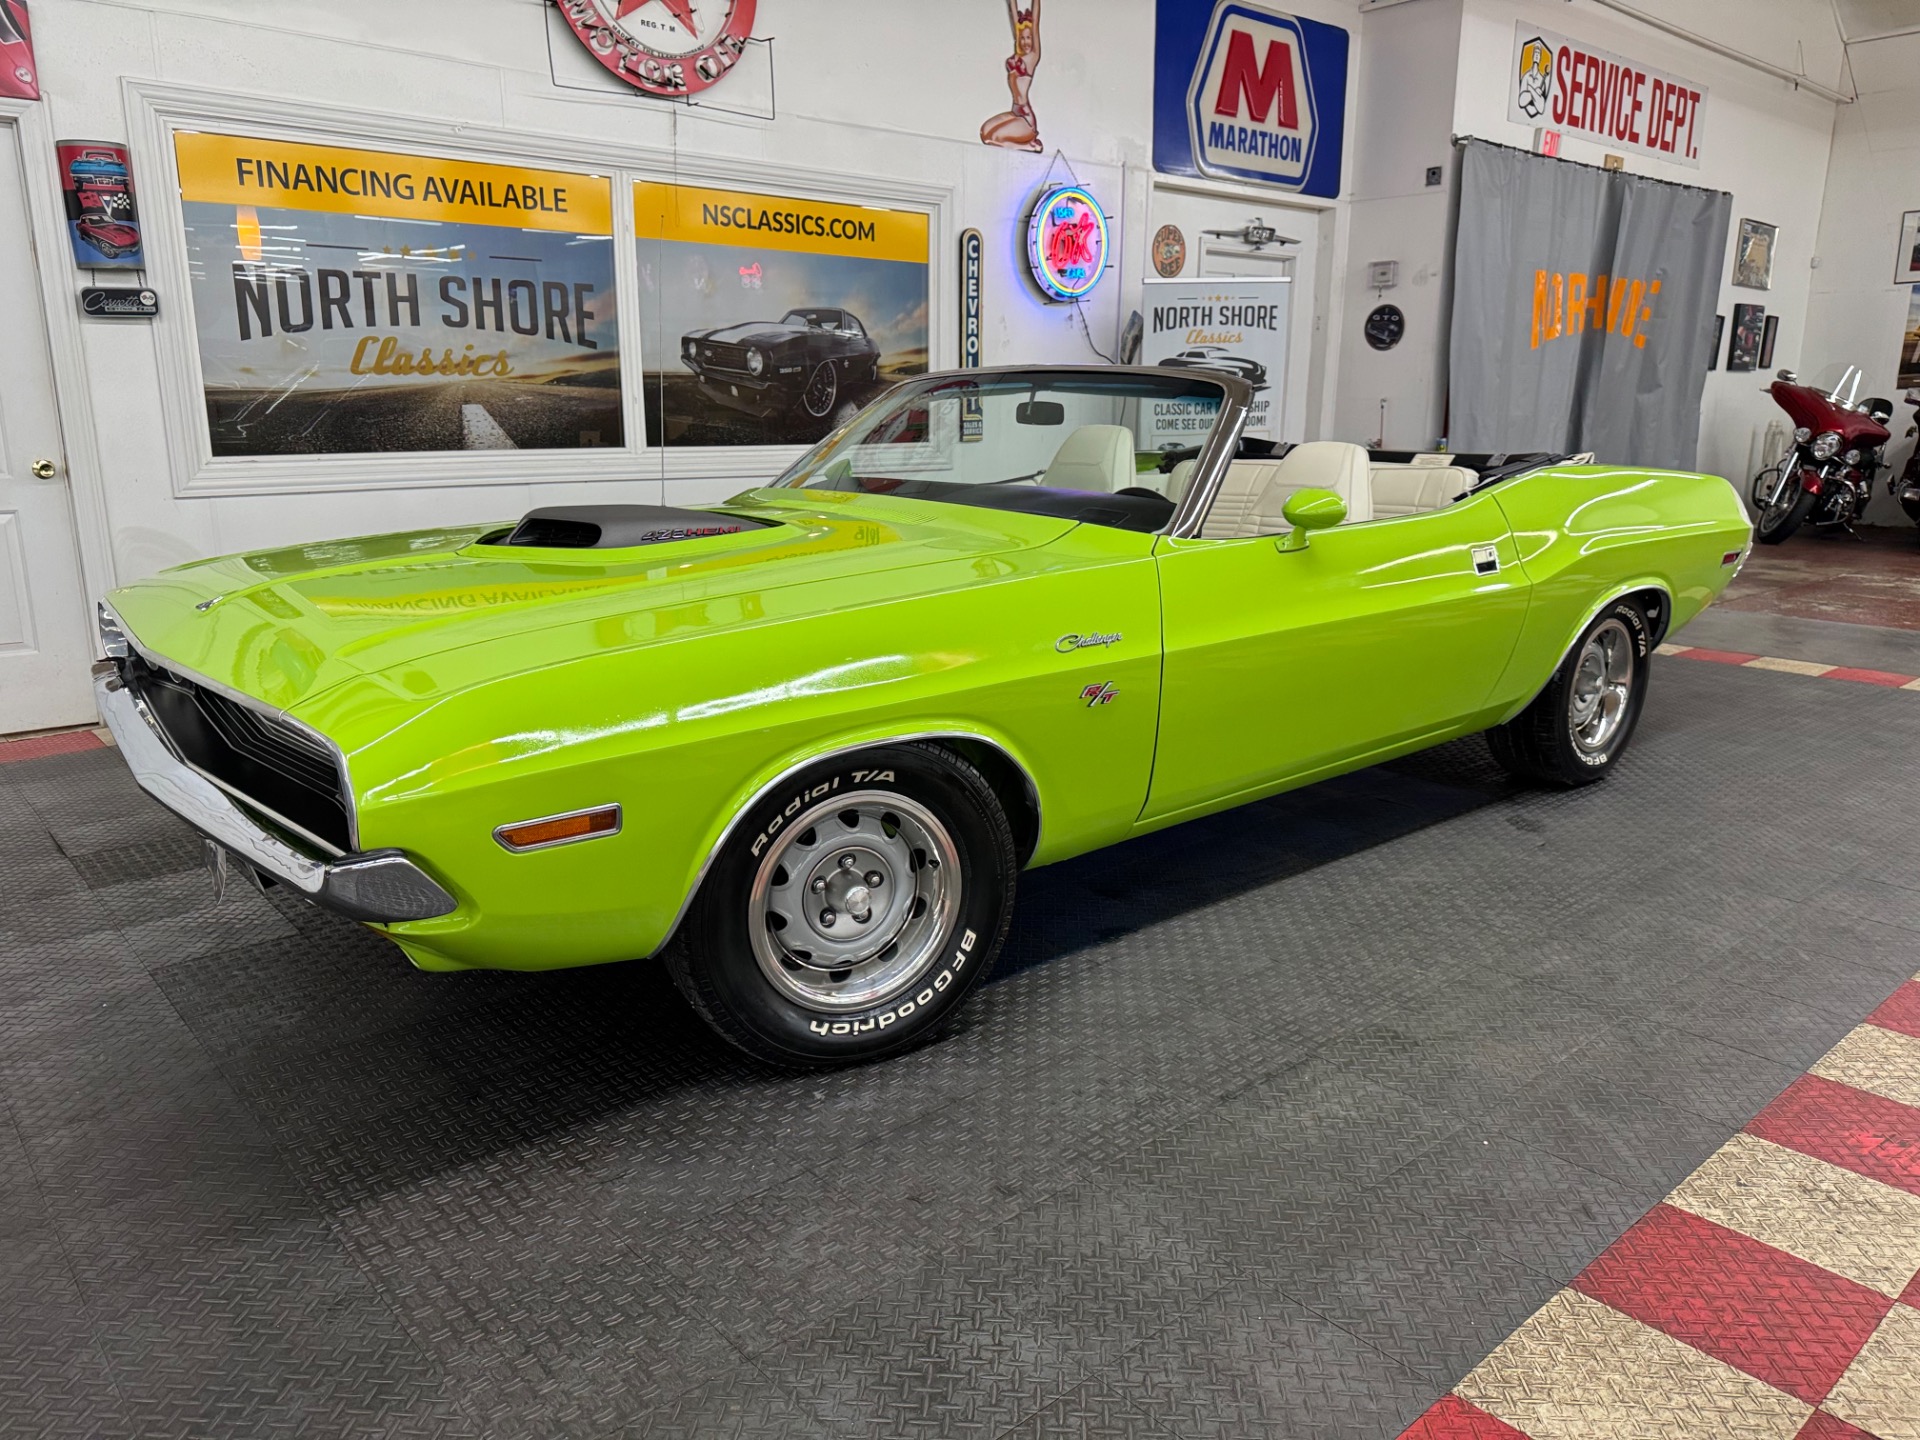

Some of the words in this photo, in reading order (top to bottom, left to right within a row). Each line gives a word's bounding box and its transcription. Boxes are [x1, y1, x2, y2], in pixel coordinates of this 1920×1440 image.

[1214, 29, 1299, 131] M
[1552, 45, 1646, 145] SERVICE
[1646, 78, 1701, 160] DEPT.
[1208, 121, 1302, 163] MARATHON
[236, 157, 415, 201] FINANCING
[422, 176, 568, 213] AVAILABLE
[702, 203, 875, 242] NSCLASSICS.COM
[232, 263, 421, 341] NORTH
[439, 275, 598, 350] SHORE
[1153, 306, 1213, 334] NORTH
[1219, 305, 1278, 331] SHORE
[350, 336, 515, 377] Classics
[1185, 329, 1243, 344] Classics
[1154, 402, 1192, 416] CLASSIC
[1194, 402, 1212, 415] CAR
[1156, 418, 1179, 430] COME
[1182, 418, 1196, 430] SEE
[1055, 632, 1123, 653] Challenger
[1079, 680, 1120, 707] R/T
[750, 776, 840, 857] Radial
[851, 770, 895, 783] T/A
[809, 928, 977, 1037] BFGoodrich
